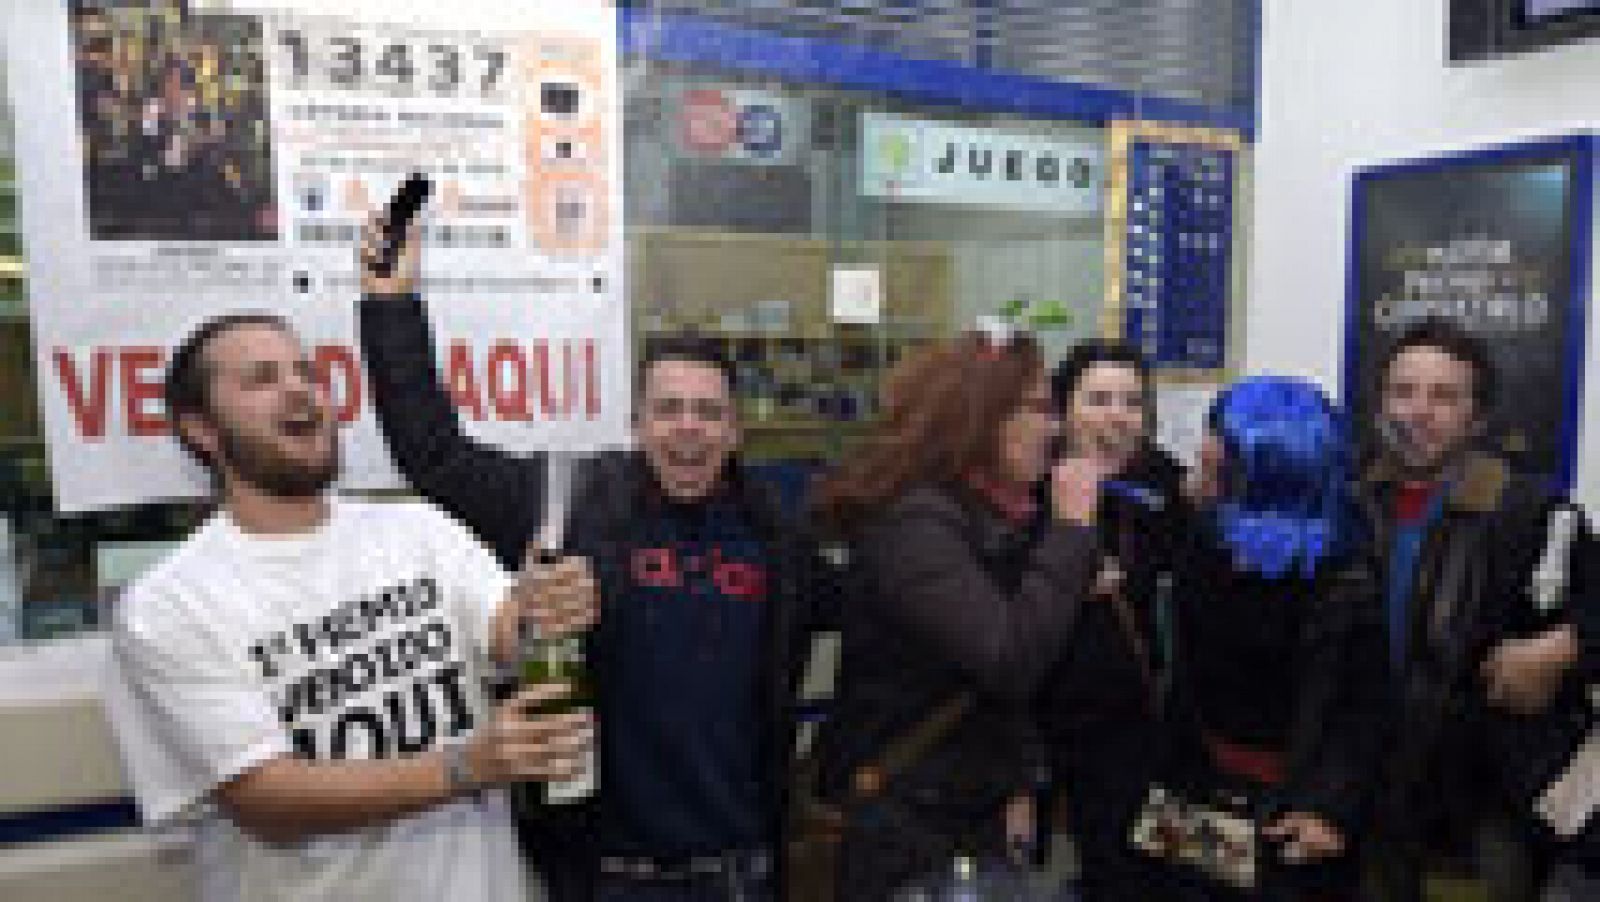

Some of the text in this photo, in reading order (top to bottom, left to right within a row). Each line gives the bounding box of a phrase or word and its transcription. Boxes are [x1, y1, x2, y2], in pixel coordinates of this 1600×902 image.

[278, 30, 509, 96] 13437
[934, 142, 1091, 189] JUEGO
[292, 577, 440, 656] PREMIO
